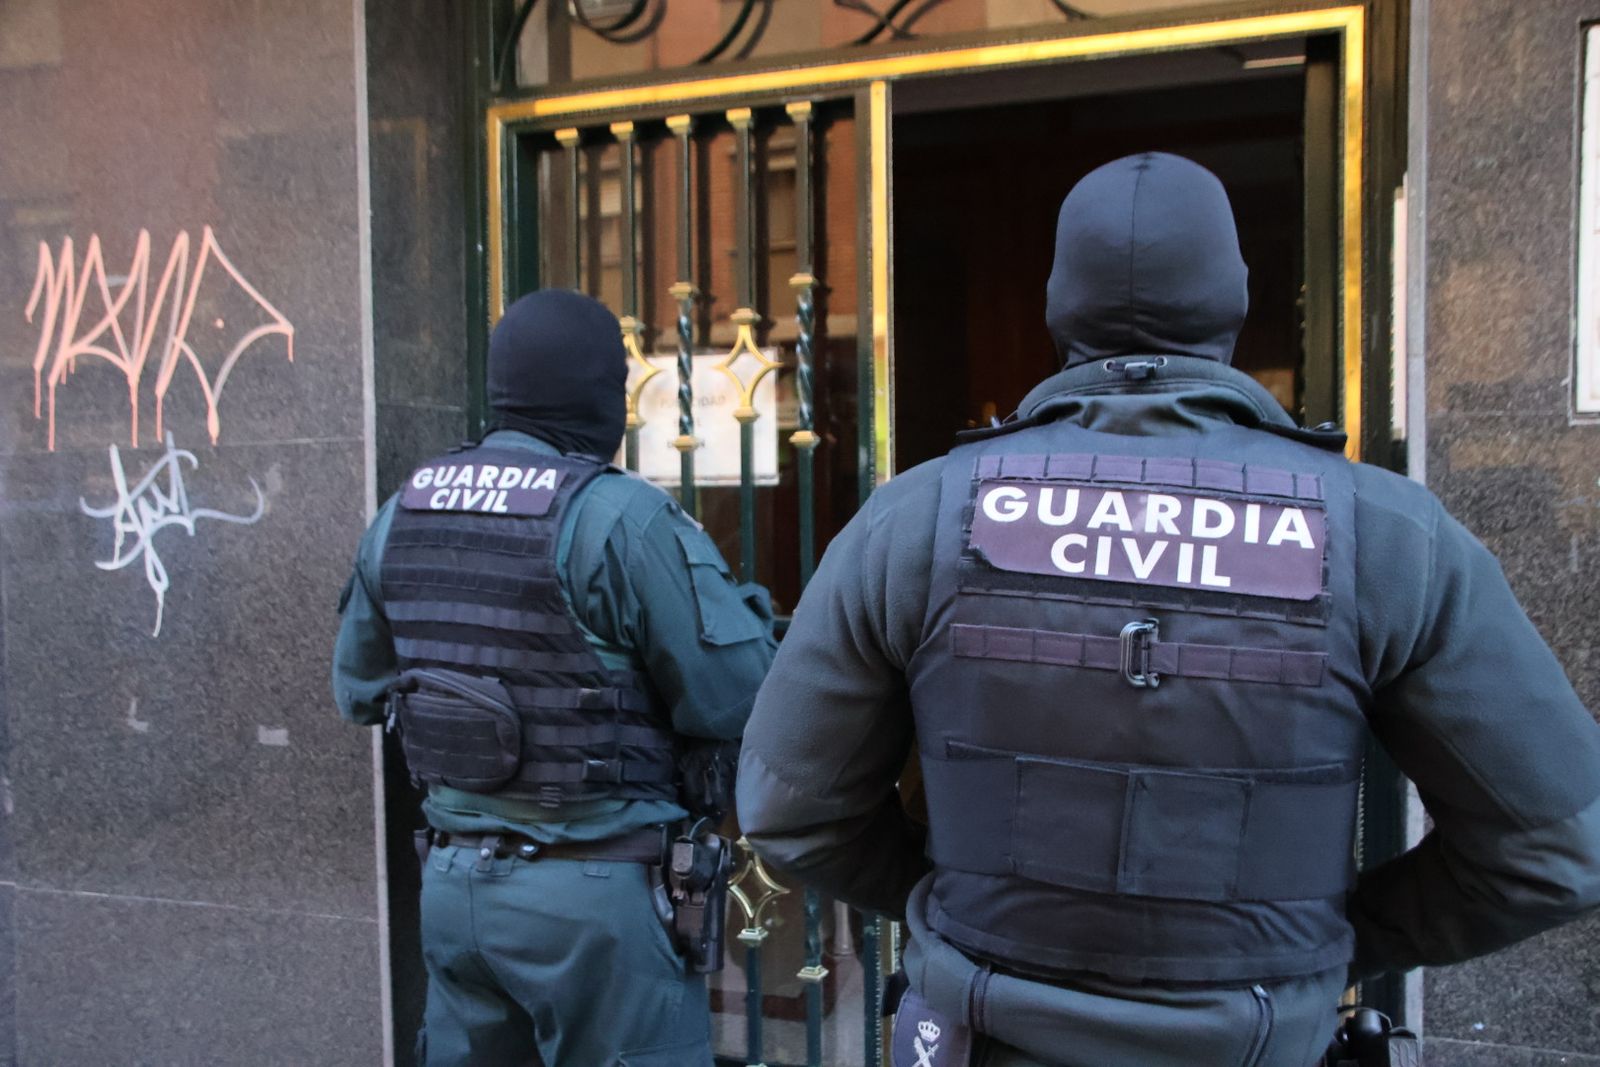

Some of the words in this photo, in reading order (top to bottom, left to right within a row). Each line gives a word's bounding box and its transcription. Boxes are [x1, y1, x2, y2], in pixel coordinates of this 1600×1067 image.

[412, 465, 557, 490] GUARDIA
[429, 488, 509, 513] CIVIL
[982, 486, 1315, 549] GUARDIA
[1050, 533, 1232, 588] CIVIL
